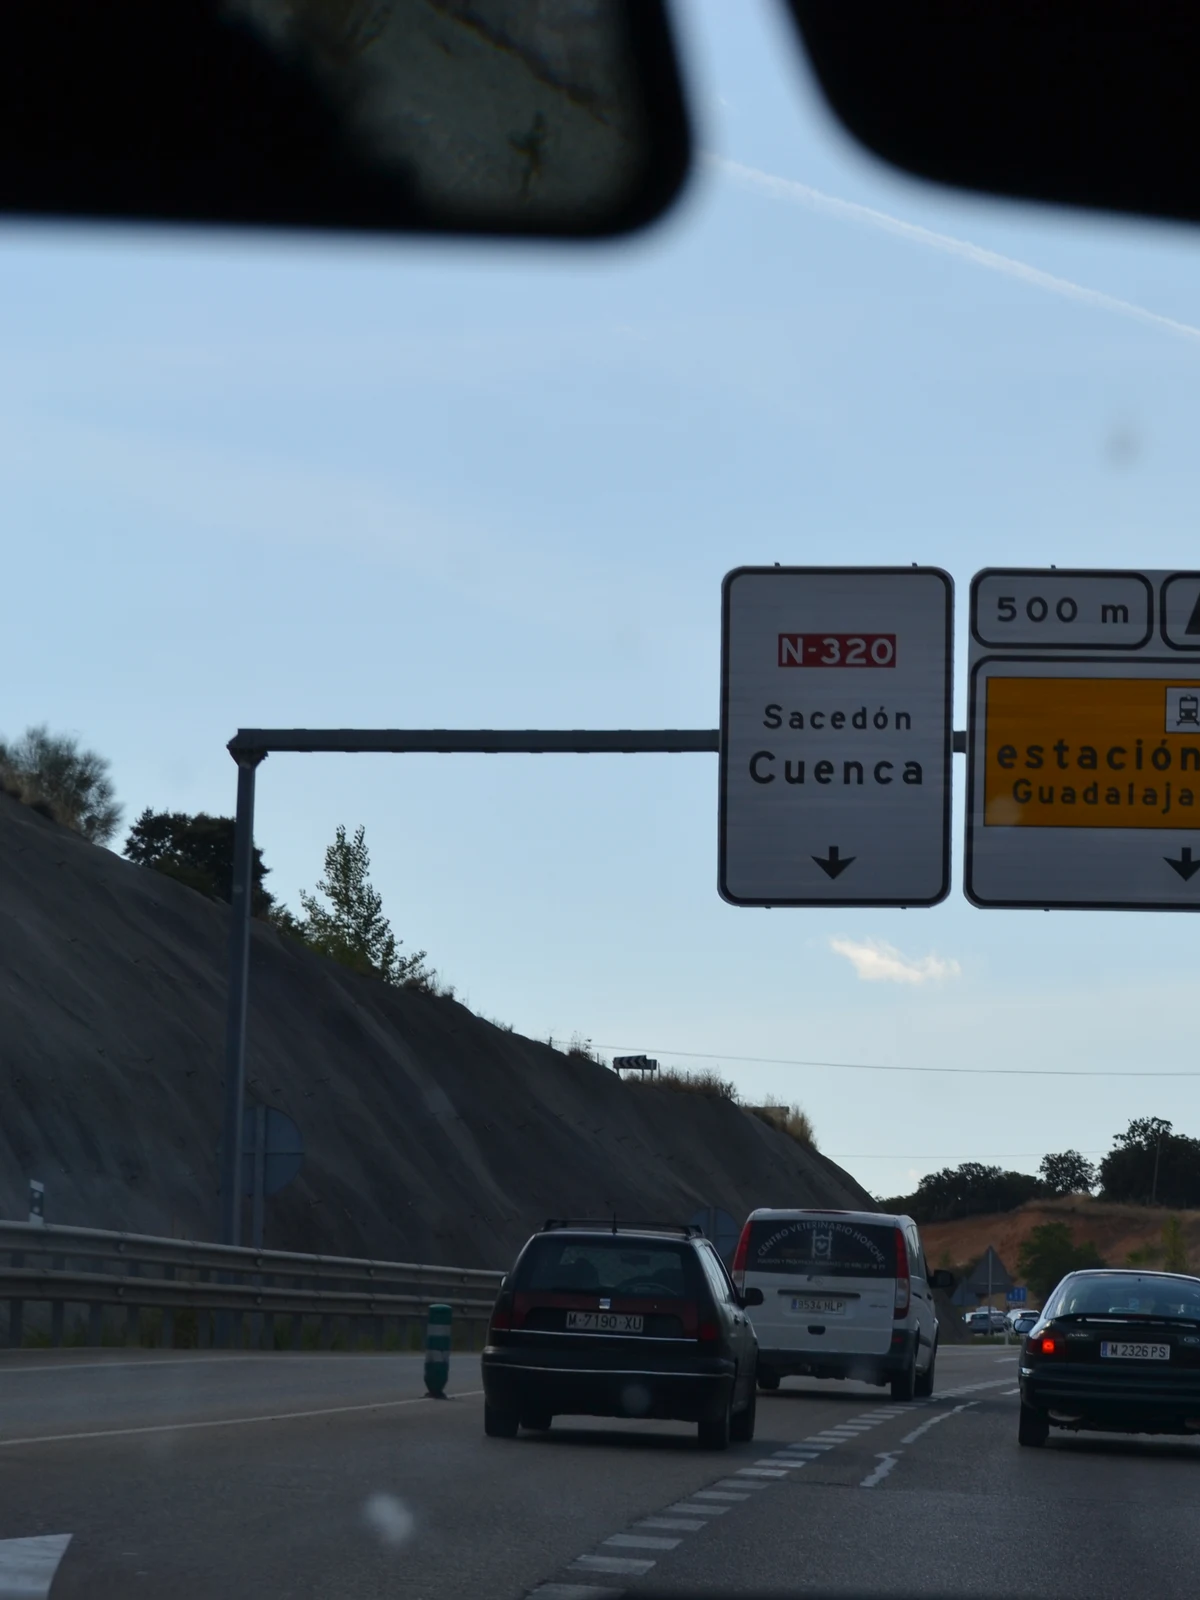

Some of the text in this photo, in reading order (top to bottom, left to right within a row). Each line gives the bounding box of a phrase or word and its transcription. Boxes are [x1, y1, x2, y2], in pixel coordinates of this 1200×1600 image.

[997, 596, 1129, 624] 500 m
[781, 637, 894, 665] N-320
[762, 703, 911, 730] Sacedón
[748, 750, 923, 785] Cuenca
[757, 1221, 885, 1263] CENTRO VETERINARIO HORCHE
[1110, 1344, 1166, 1358] M 2326 PS
